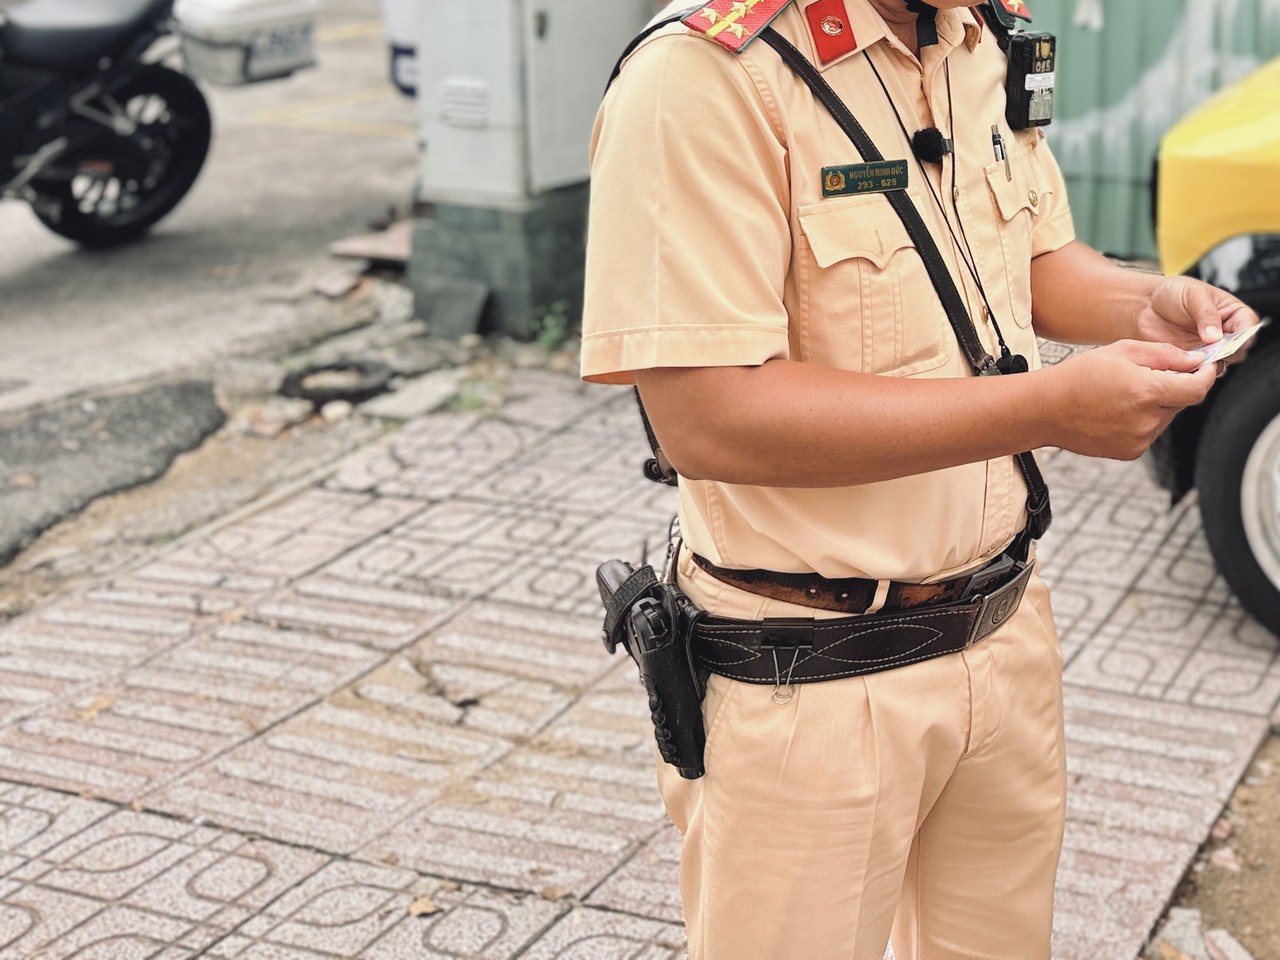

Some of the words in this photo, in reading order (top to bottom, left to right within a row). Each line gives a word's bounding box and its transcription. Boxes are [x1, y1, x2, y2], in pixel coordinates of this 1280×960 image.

[849, 166, 874, 180] NGUYỄN
[874, 167, 891, 177] MINH
[891, 164, 904, 175] ĐỨC
[857, 180, 874, 190] 293
[880, 178, 897, 188] 625
